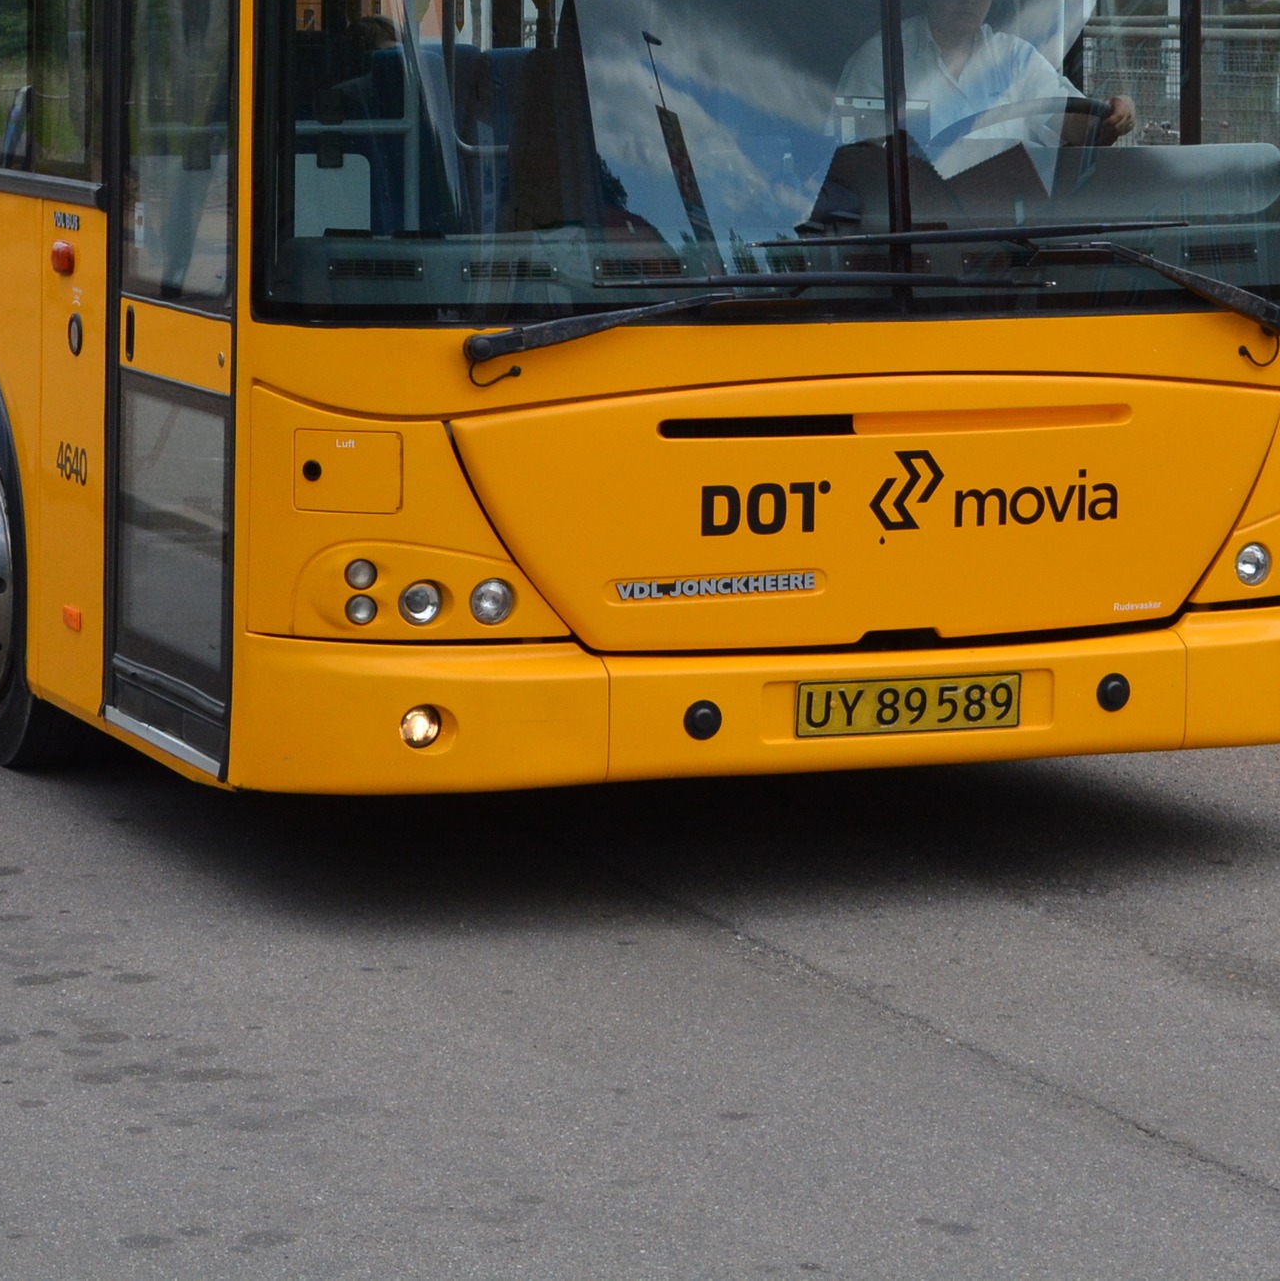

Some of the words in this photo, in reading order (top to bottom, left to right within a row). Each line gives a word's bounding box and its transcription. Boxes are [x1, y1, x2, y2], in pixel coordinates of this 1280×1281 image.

[335, 438, 355, 449] Luft
[56, 441, 87, 486] 4640
[701, 480, 831, 536] DOT
[954, 469, 1118, 527] movia
[616, 581, 664, 600] VDL
[669, 572, 816, 597] JONCKHEERE
[1113, 601, 1162, 612] Rudevasker
[805, 689, 865, 728] UY
